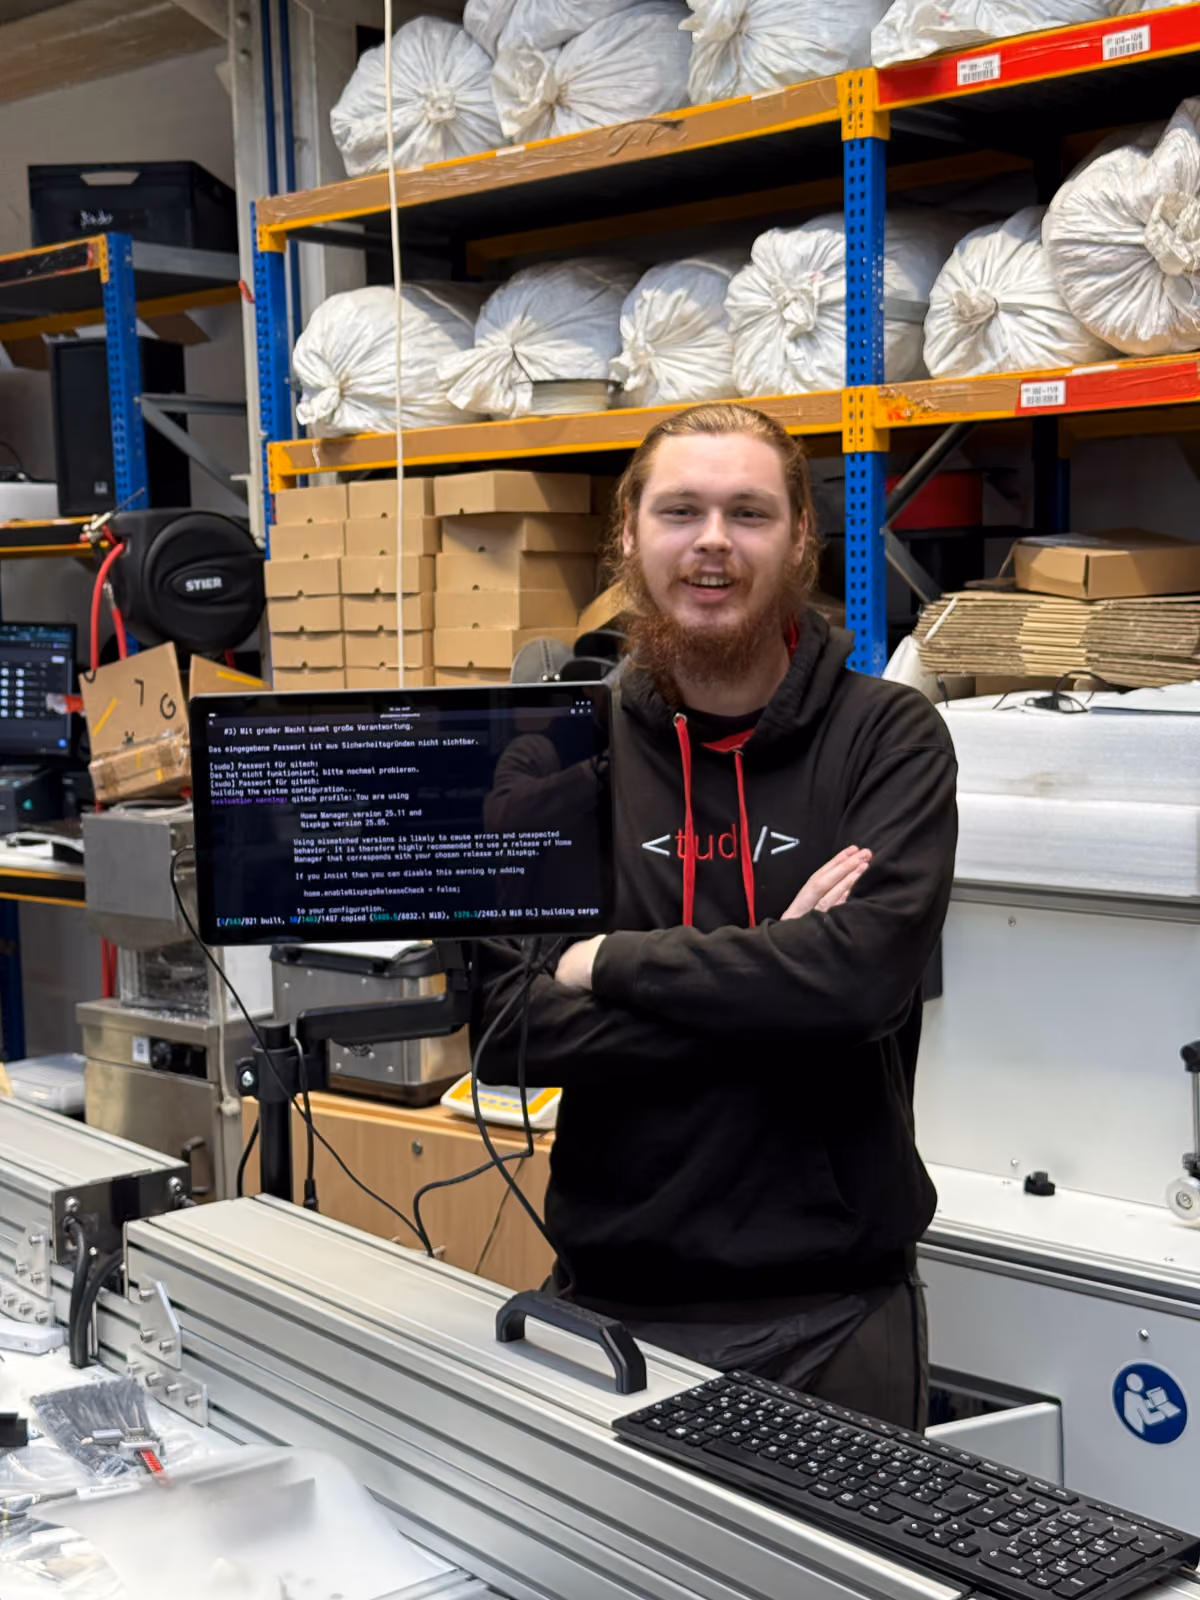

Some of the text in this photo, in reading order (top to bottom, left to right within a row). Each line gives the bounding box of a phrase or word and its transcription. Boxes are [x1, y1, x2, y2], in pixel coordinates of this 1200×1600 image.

[185, 576, 223, 592] STIER
[256, 726, 281, 736] großer
[333, 724, 353, 734] große
[358, 723, 413, 732] Verantwortung.
[209, 745, 221, 753] Das
[225, 744, 269, 754] eingegebene
[273, 742, 306, 751] Passwort
[310, 742, 322, 750] ist
[342, 740, 415, 749] Sicherheitsgründen
[419, 739, 439, 747] nicht
[443, 738, 479, 746] sichtbar.
[238, 761, 270, 769] Passwort
[274, 760, 286, 768] für
[210, 766, 419, 779] Das hat nicht funktioniert, bitte nochmal probieren.
[239, 778, 271, 787] Passwort
[275, 778, 287, 786] für
[211, 788, 243, 797] building
[247, 787, 259, 795] the
[263, 787, 287, 796] system
[320, 793, 351, 803] profile:
[356, 793, 368, 801] You
[389, 792, 409, 801] using
[321, 811, 349, 820] Manager
[353, 810, 381, 818] version
[301, 820, 329, 829] Nixpkgs
[333, 819, 362, 827] version
[294, 838, 314, 847] Using
[318, 836, 358, 845] mismatched
[362, 836, 395, 844] versions
[399, 835, 407, 843] is
[411, 834, 435, 843] likely
[439, 834, 447, 842] to
[503, 832, 515, 840] and
[519, 831, 560, 840] unexpected
[334, 845, 343, 853] It
[347, 845, 355, 853] is
[359, 844, 395, 852] therefore
[399, 843, 423, 853] highly
[427, 842, 471, 850] recommended
[512, 840, 540, 848] release
[556, 839, 572, 847] Home
[295, 849, 539, 864] Manager that corresponds with your chosen release of Nixpkgs.
[295, 872, 303, 880] If
[307, 873, 319, 881] you
[324, 871, 348, 879] insist
[372, 871, 384, 879] you
[404, 869, 432, 877] disable
[436, 868, 452, 876] this
[456, 867, 484, 876] warning
[488, 867, 496, 876] by
[501, 866, 525, 875] adding
[309, 907, 325, 916] your
[329, 905, 384, 914] configuration.
[342, 913, 366, 923] copied
[510, 909, 522, 917] MiB
[542, 908, 574, 917] building
